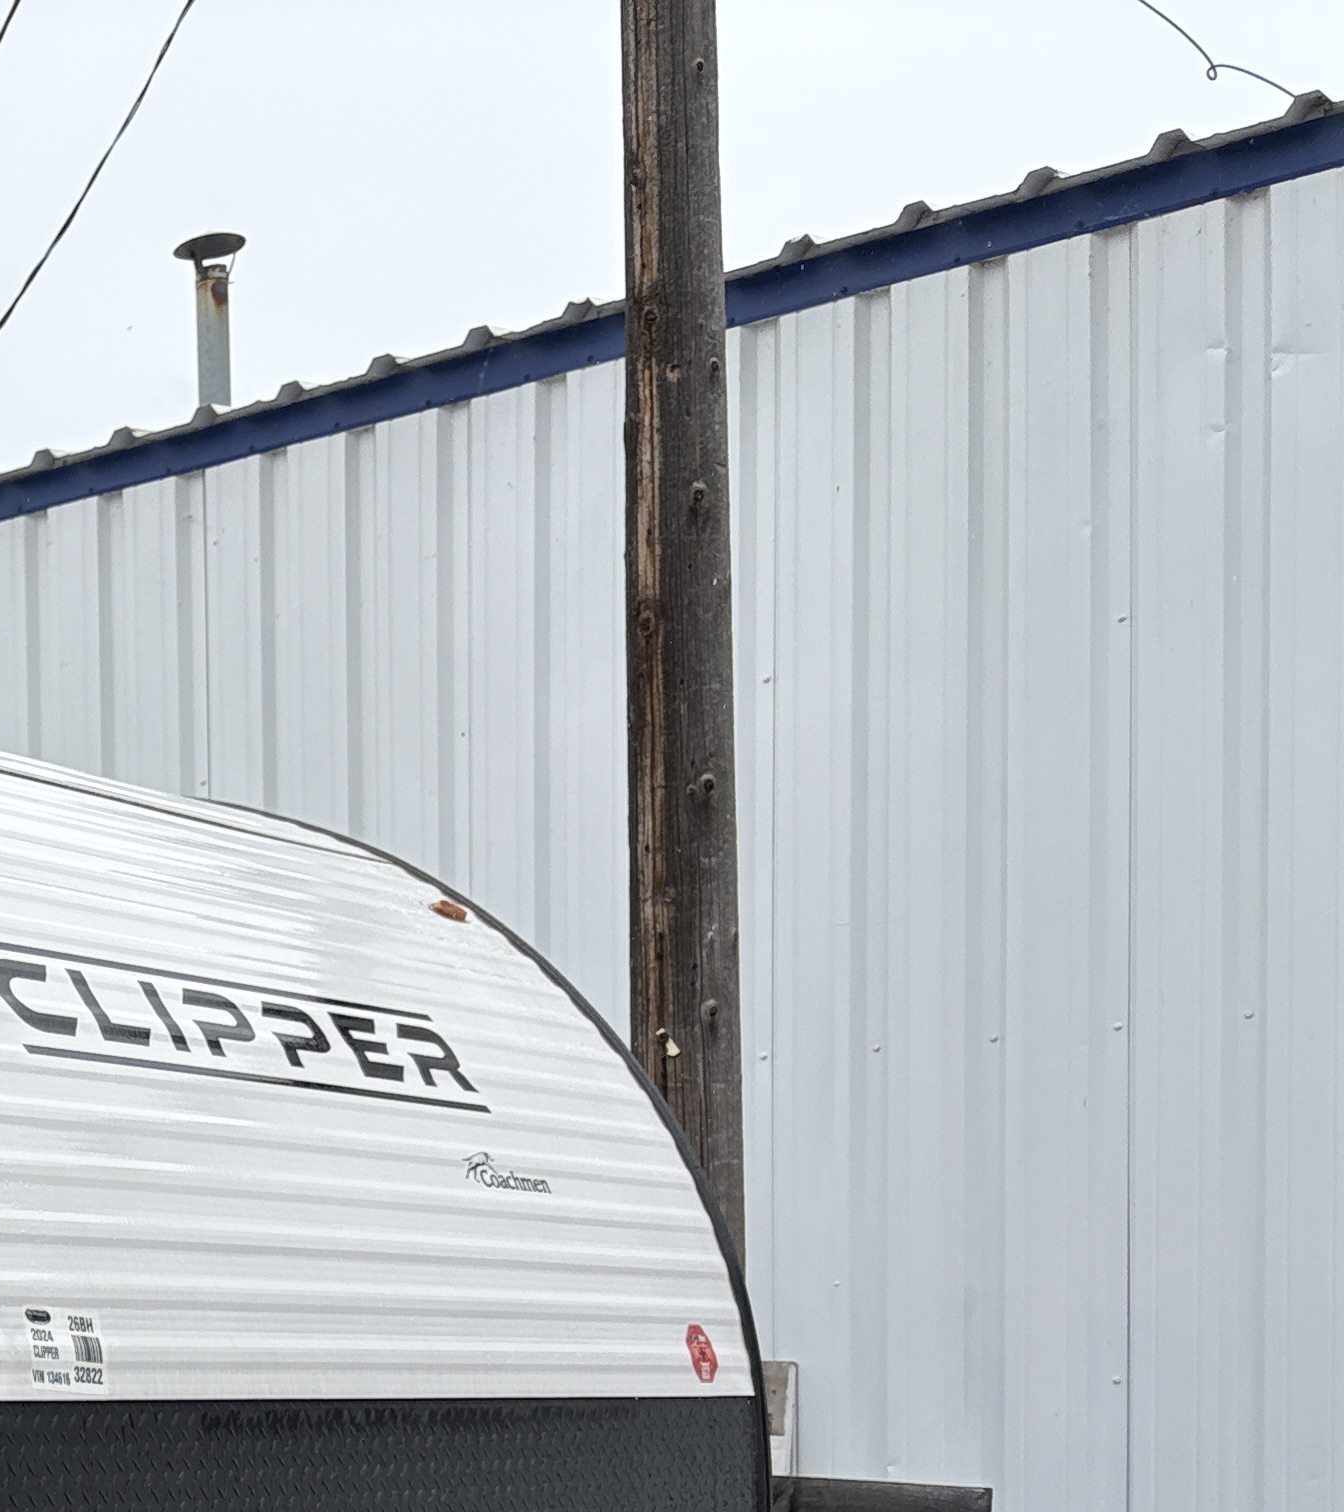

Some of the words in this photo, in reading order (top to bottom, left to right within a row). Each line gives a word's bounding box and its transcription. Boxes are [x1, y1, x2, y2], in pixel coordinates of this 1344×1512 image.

[479, 1169, 552, 1195] Coachmen
[67, 1314, 95, 1334] 26BH
[33, 1344, 60, 1360] CLIPPER
[73, 1365, 104, 1385] 32822
